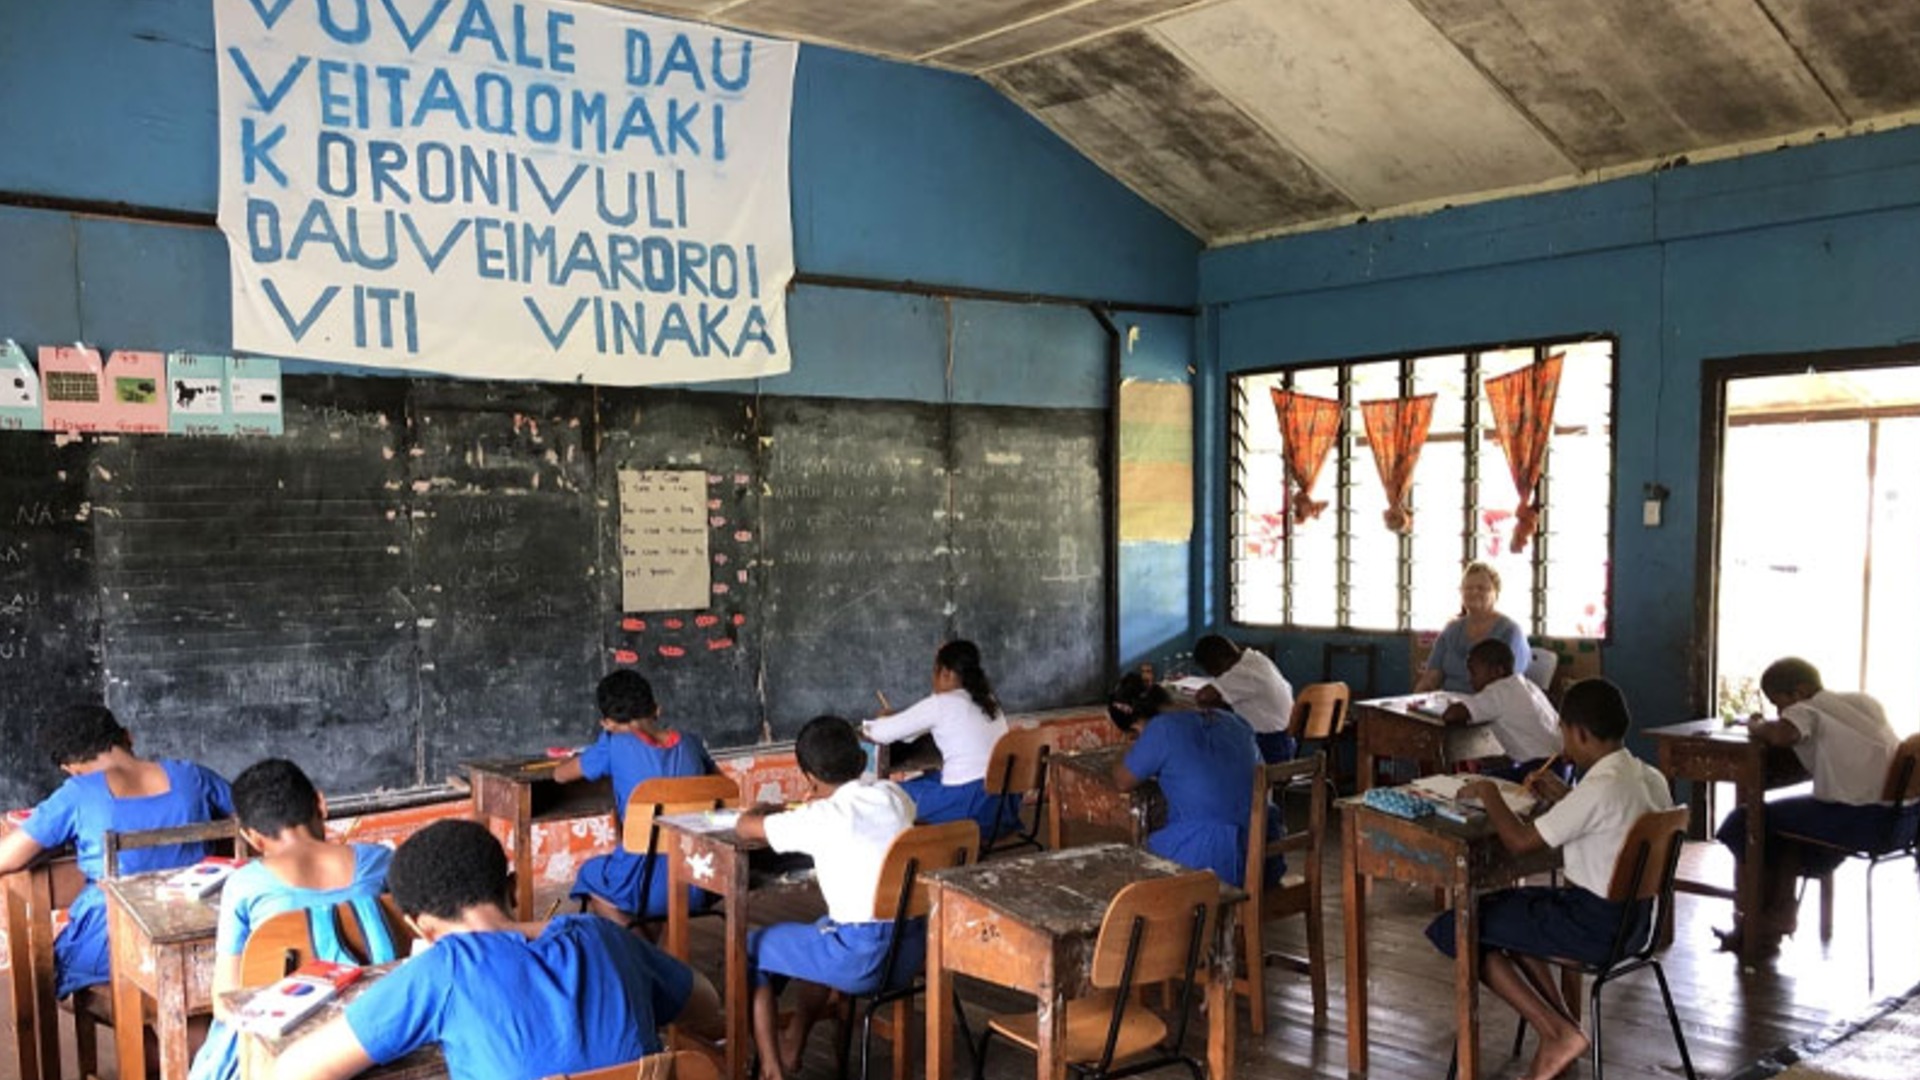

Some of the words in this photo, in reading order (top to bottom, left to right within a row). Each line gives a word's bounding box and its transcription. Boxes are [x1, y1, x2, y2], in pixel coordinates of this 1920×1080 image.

[229, 47, 725, 161] VEITAQOMAKI
[626, 27, 752, 92] DAU
[246, 199, 760, 300] DAUVEIMAROROI
[262, 278, 419, 353] VITI
[524, 296, 777, 358] VINAKA
